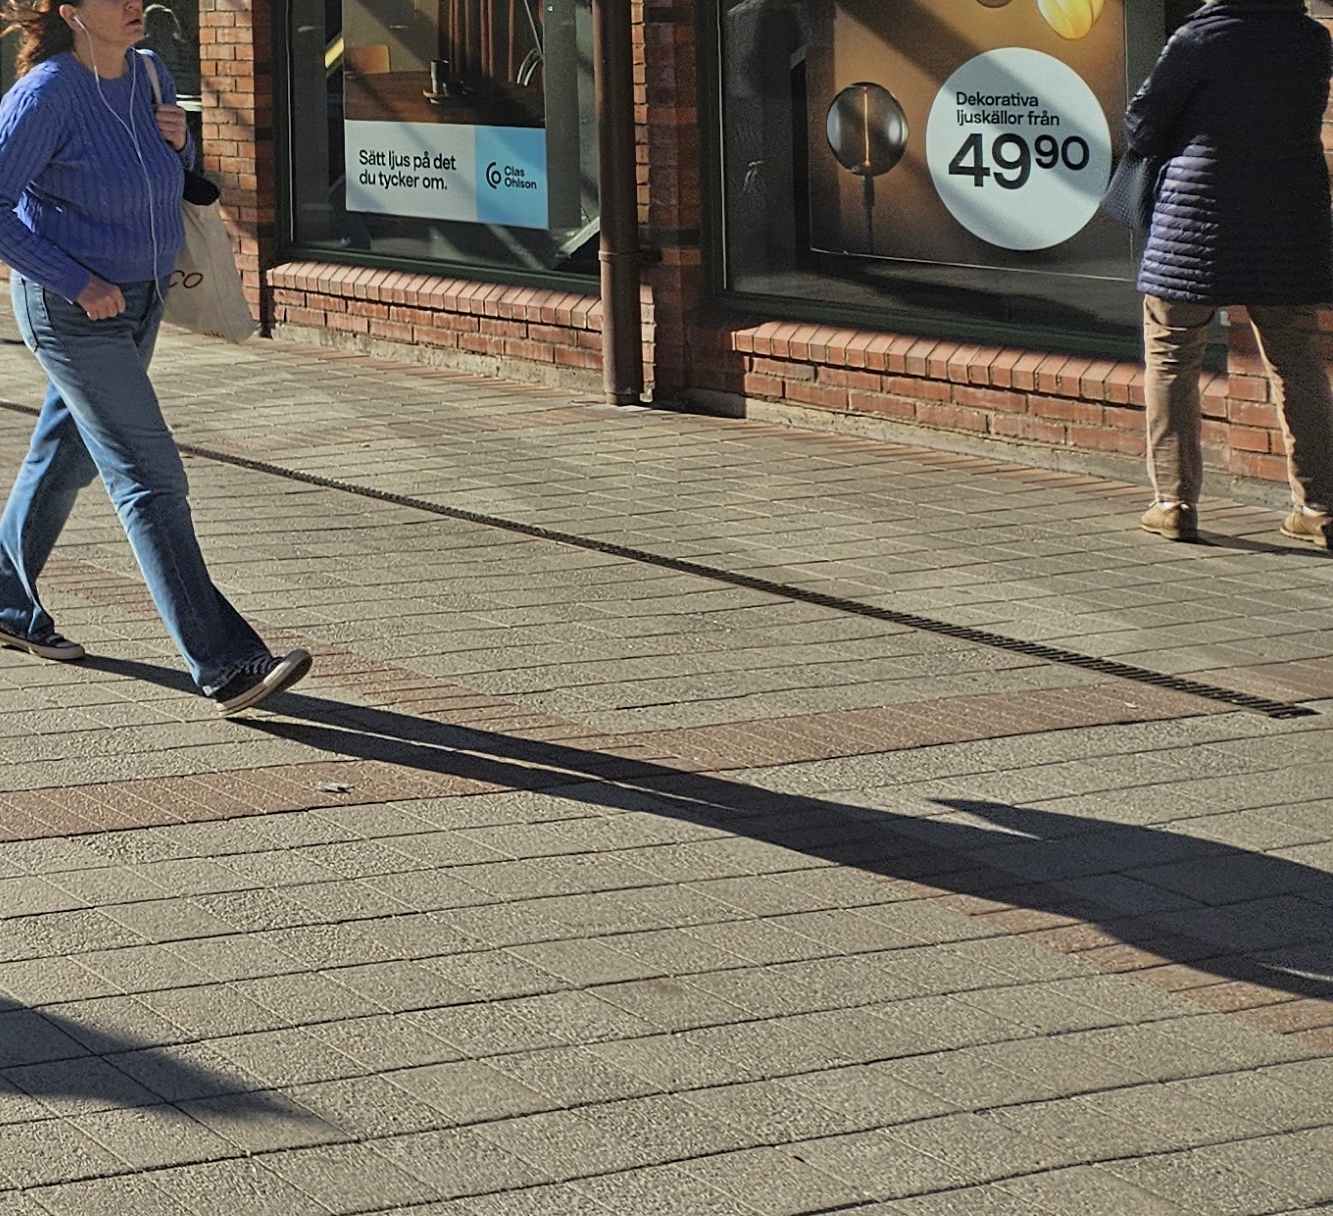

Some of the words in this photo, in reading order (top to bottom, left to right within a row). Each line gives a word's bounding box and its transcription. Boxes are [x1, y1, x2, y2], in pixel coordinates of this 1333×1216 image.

[956, 92, 1039, 107] Dekorativa
[956, 109, 1024, 127] ljuskällor
[1027, 110, 1060, 126] från
[359, 149, 387, 167] Sätt
[388, 150, 411, 170] ljus
[413, 151, 430, 172] på
[433, 153, 456, 170] det
[359, 169, 376, 186] du
[378, 171, 420, 190] tycker
[422, 176, 448, 190] om.
[504, 165, 525, 178] Clas
[504, 177, 538, 190] Ohlson
